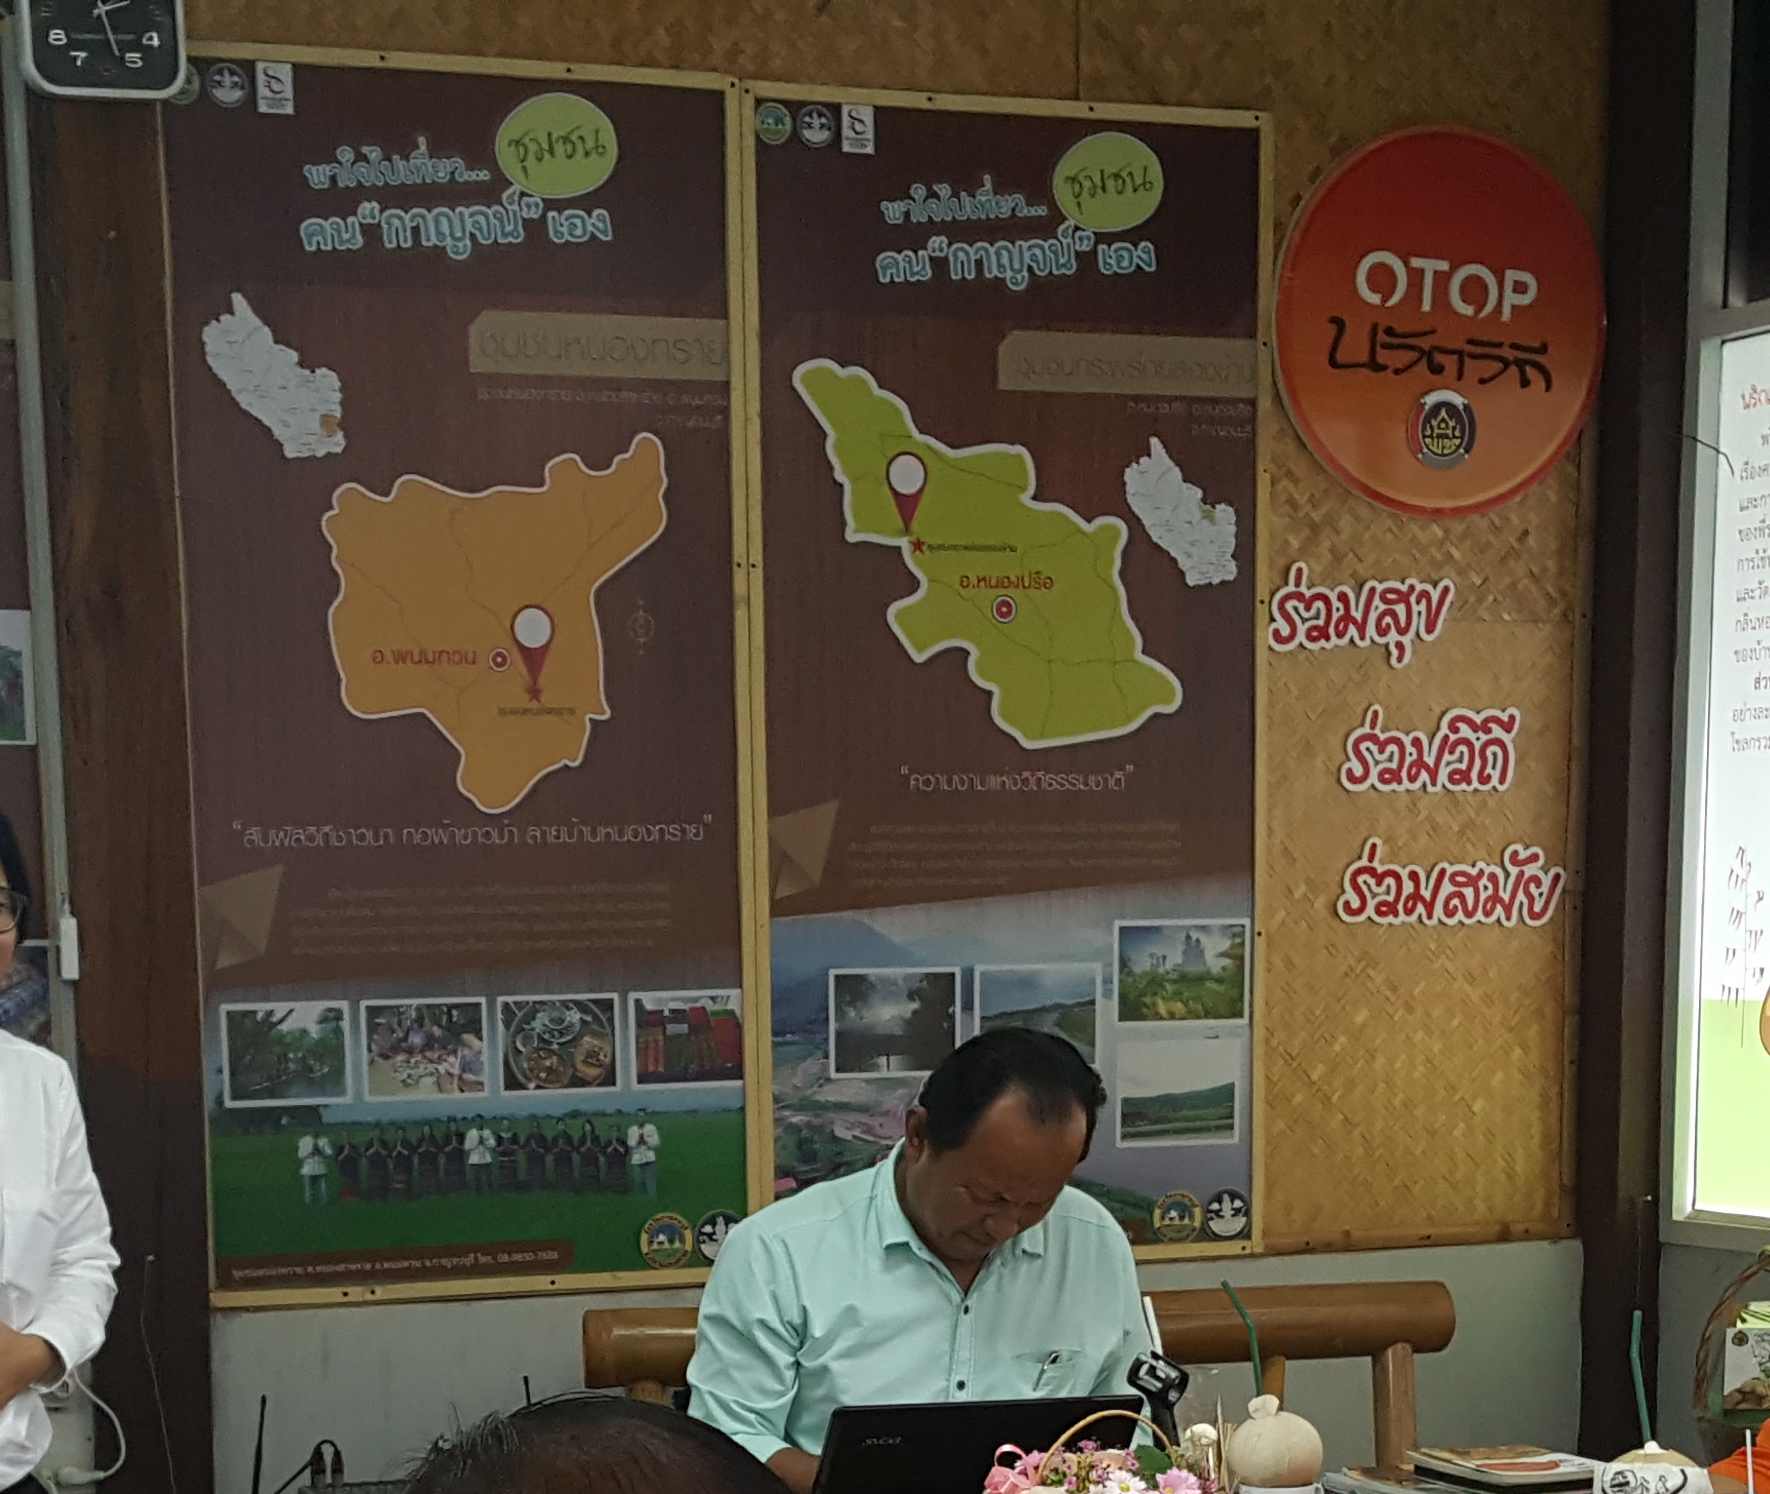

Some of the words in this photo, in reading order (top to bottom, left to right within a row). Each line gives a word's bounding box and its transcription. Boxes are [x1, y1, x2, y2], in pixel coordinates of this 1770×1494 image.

[48, 29, 68, 46] 8
[141, 31, 161, 48] 4
[69, 50, 89, 67] 7
[124, 52, 144, 68] 5
[508, 125, 610, 181] ชุมชน
[1063, 164, 1155, 216] ชุมชน
[1355, 249, 1538, 322] OTOP
[1270, 563, 1453, 667] ร่วมสุข
[1341, 705, 1521, 792] ร่วมวิถี
[1338, 838, 1565, 927] ร่วมสมัย
